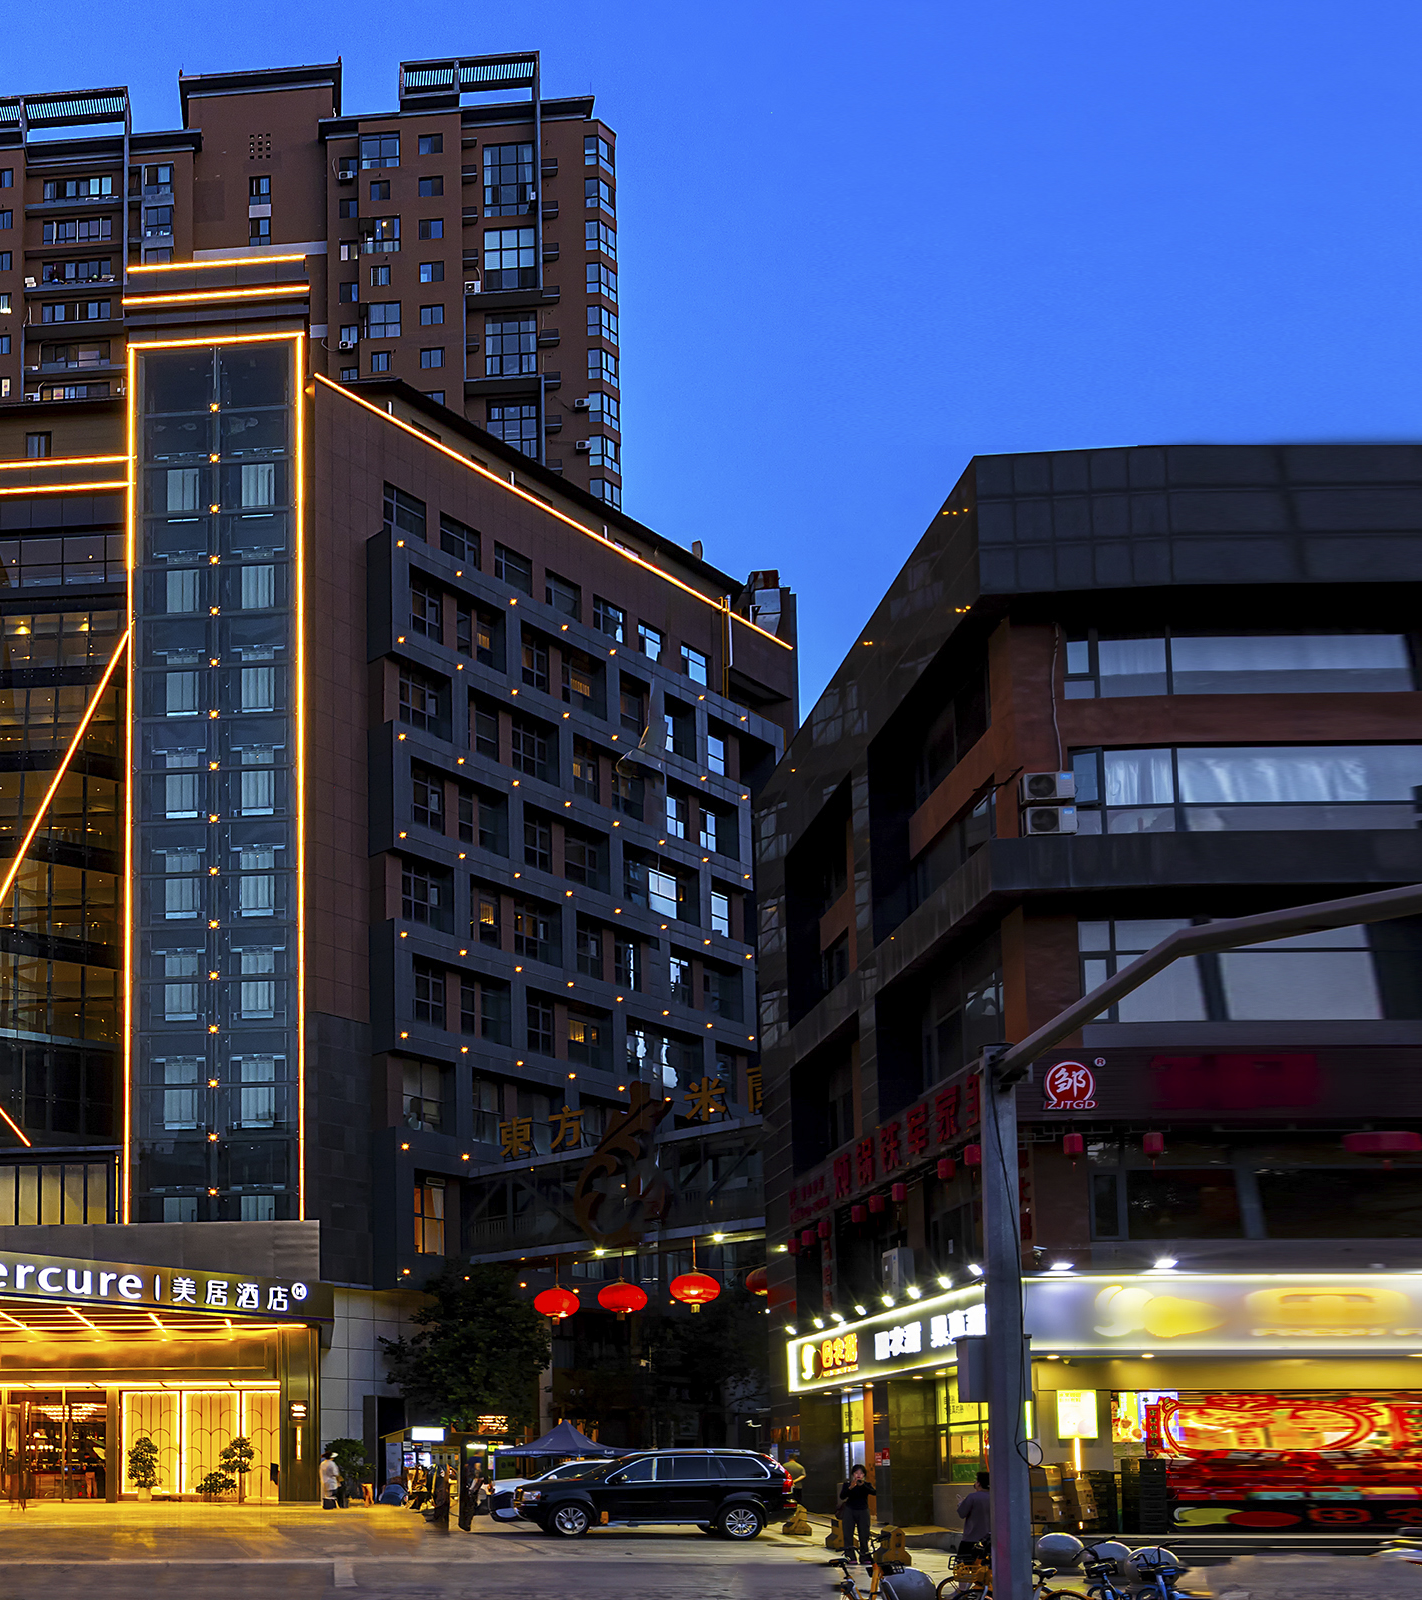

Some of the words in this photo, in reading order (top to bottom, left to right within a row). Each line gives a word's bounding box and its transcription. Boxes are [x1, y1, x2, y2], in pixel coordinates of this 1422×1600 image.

[1054, 1067, 1086, 1097] 邹
[1047, 1100, 1096, 1109] ZJTGD
[499, 1105, 585, 1158] 東方
[172, 1277, 289, 1311] 美居酒店
